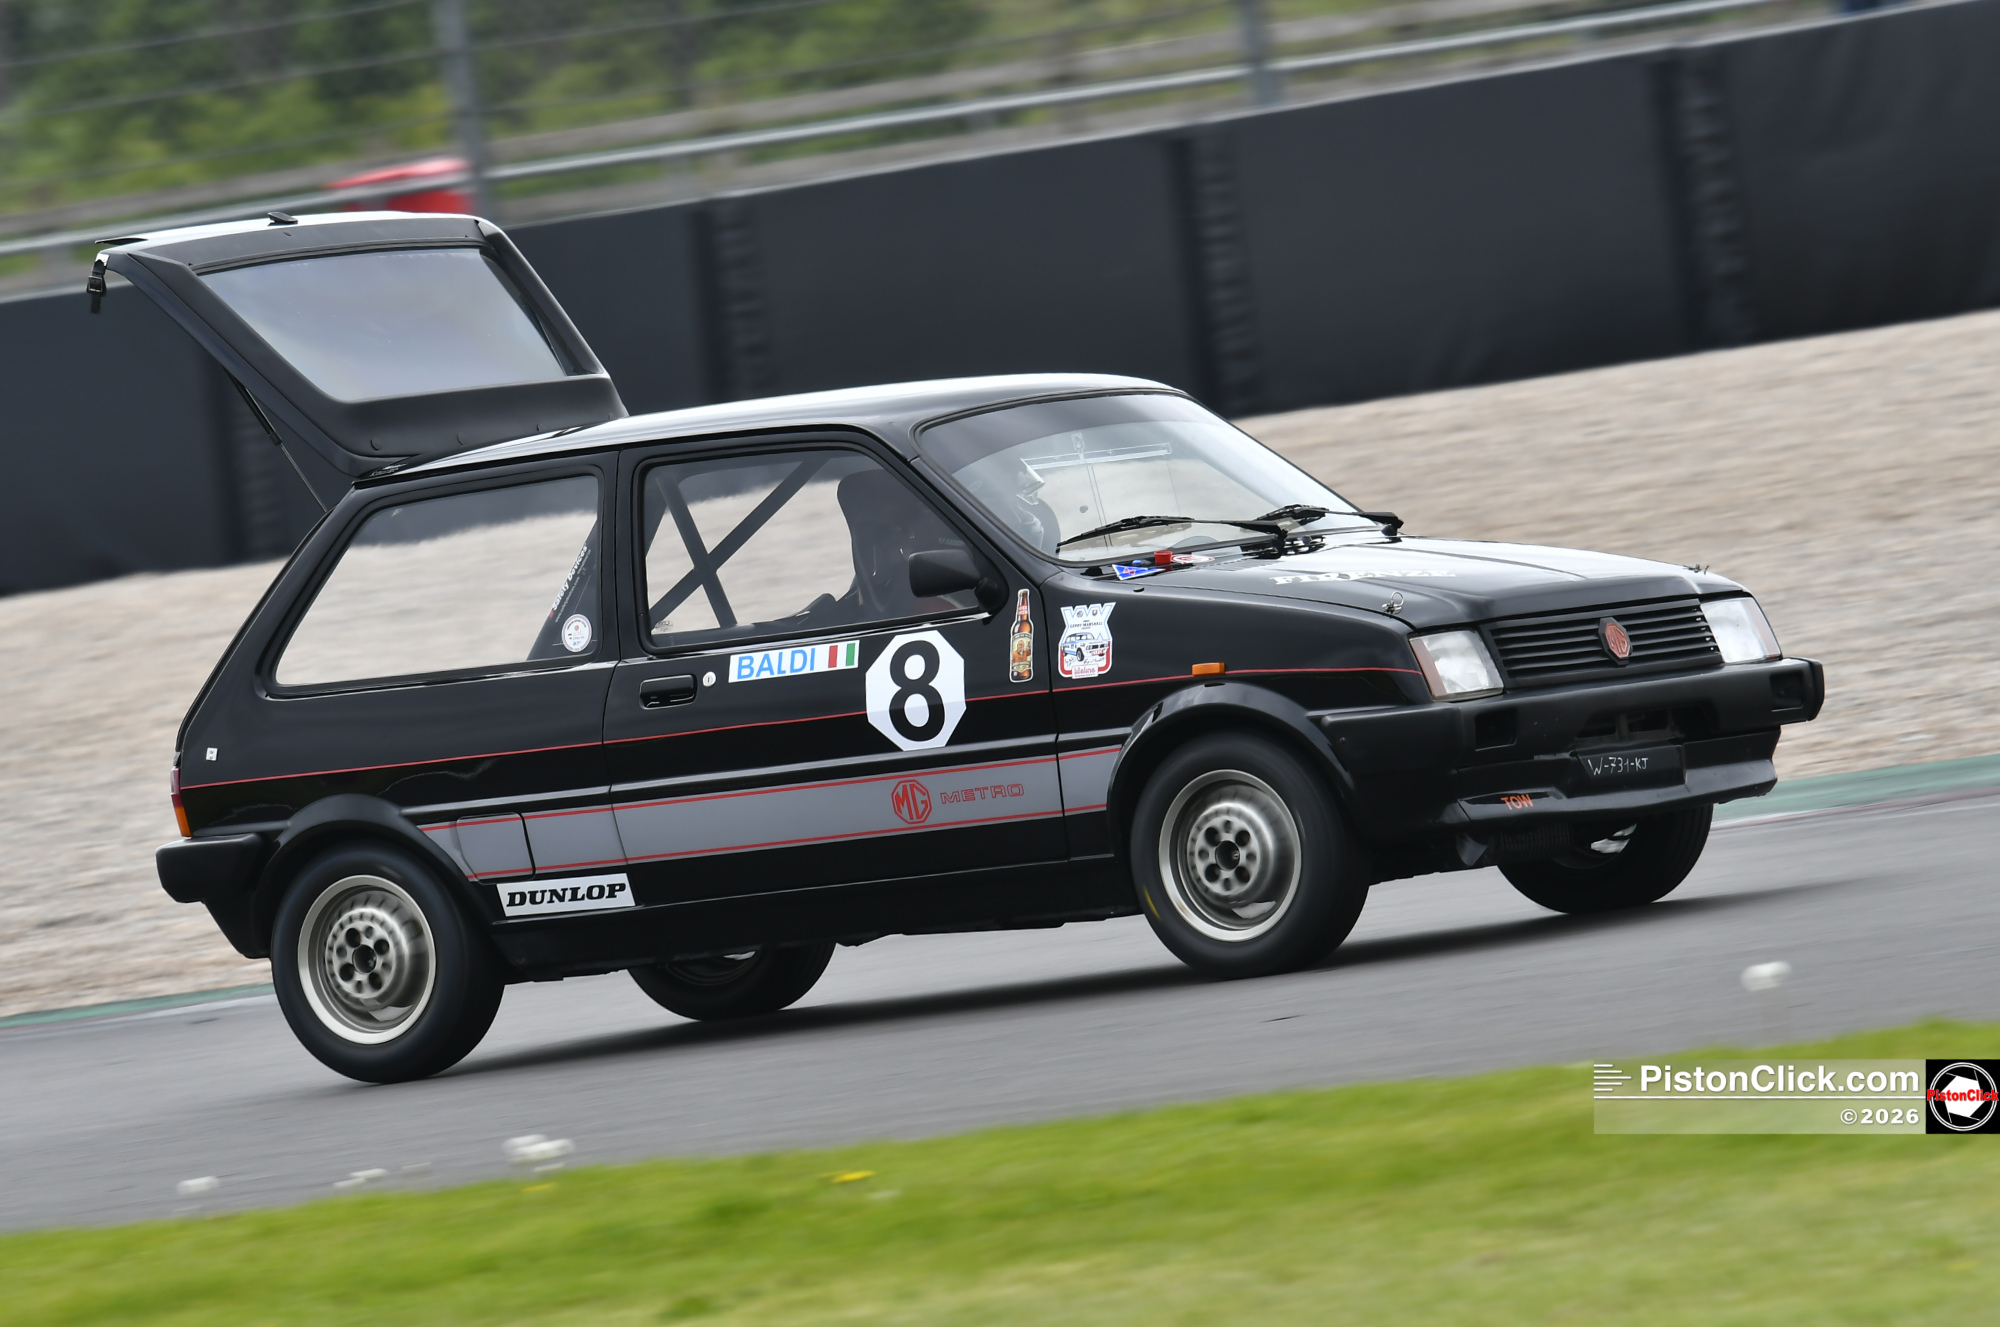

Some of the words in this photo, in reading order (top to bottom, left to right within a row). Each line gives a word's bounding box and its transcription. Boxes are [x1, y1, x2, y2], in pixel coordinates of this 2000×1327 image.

[552, 580, 570, 611] Safety
[567, 545, 588, 581] Devices
[736, 647, 816, 680] BALDI
[889, 639, 946, 743] 8
[894, 782, 930, 822] MG
[940, 783, 1025, 805] METRO
[1500, 794, 1534, 811] TOW
[506, 883, 627, 908] DUNLOP
